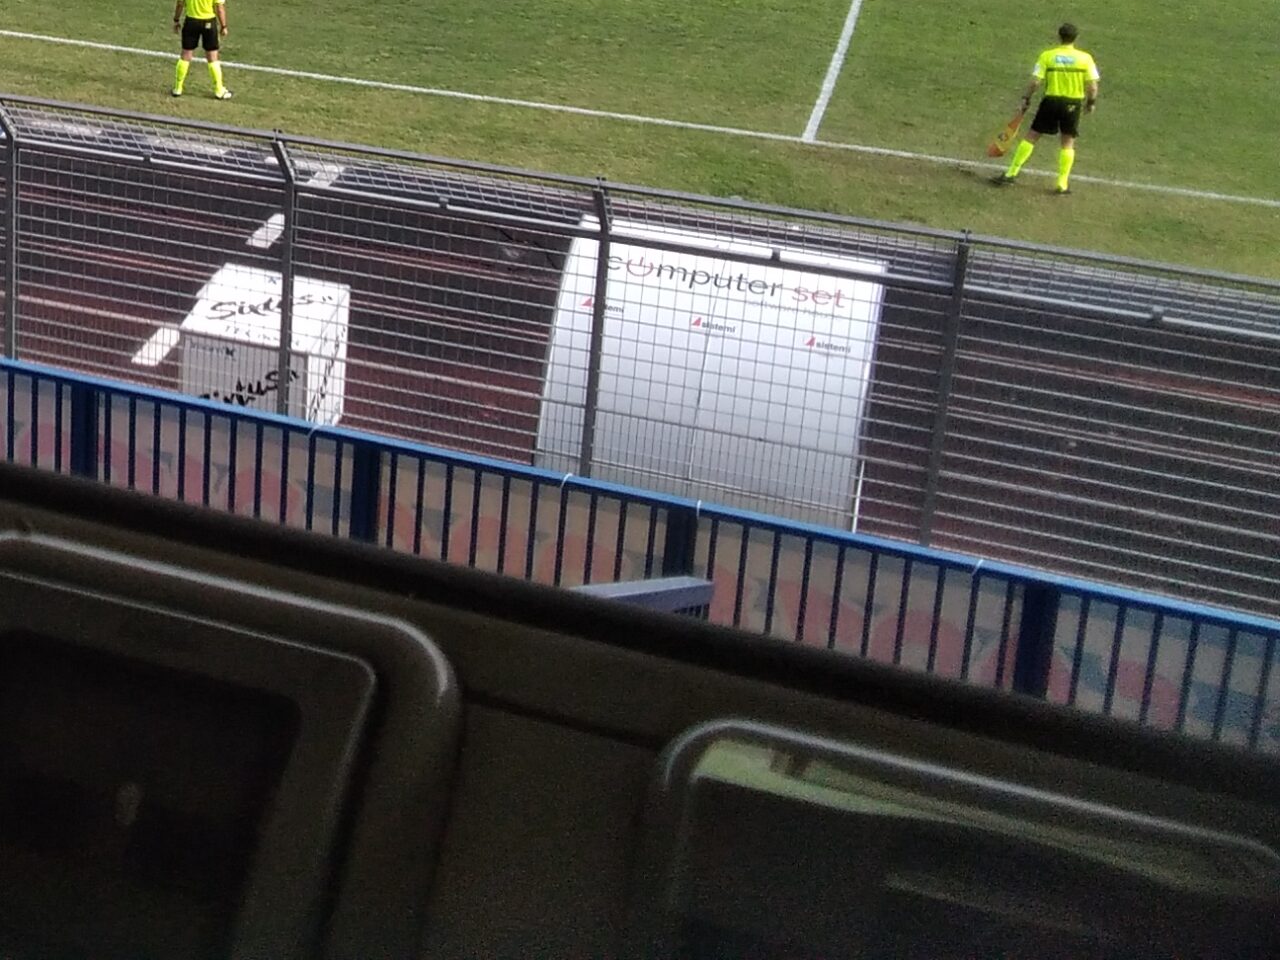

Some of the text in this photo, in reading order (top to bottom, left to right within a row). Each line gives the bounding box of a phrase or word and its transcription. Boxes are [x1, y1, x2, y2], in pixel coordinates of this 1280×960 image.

[607, 253, 846, 308] computer set
[700, 321, 736, 334] sistemi
[815, 341, 852, 354] sistemi
